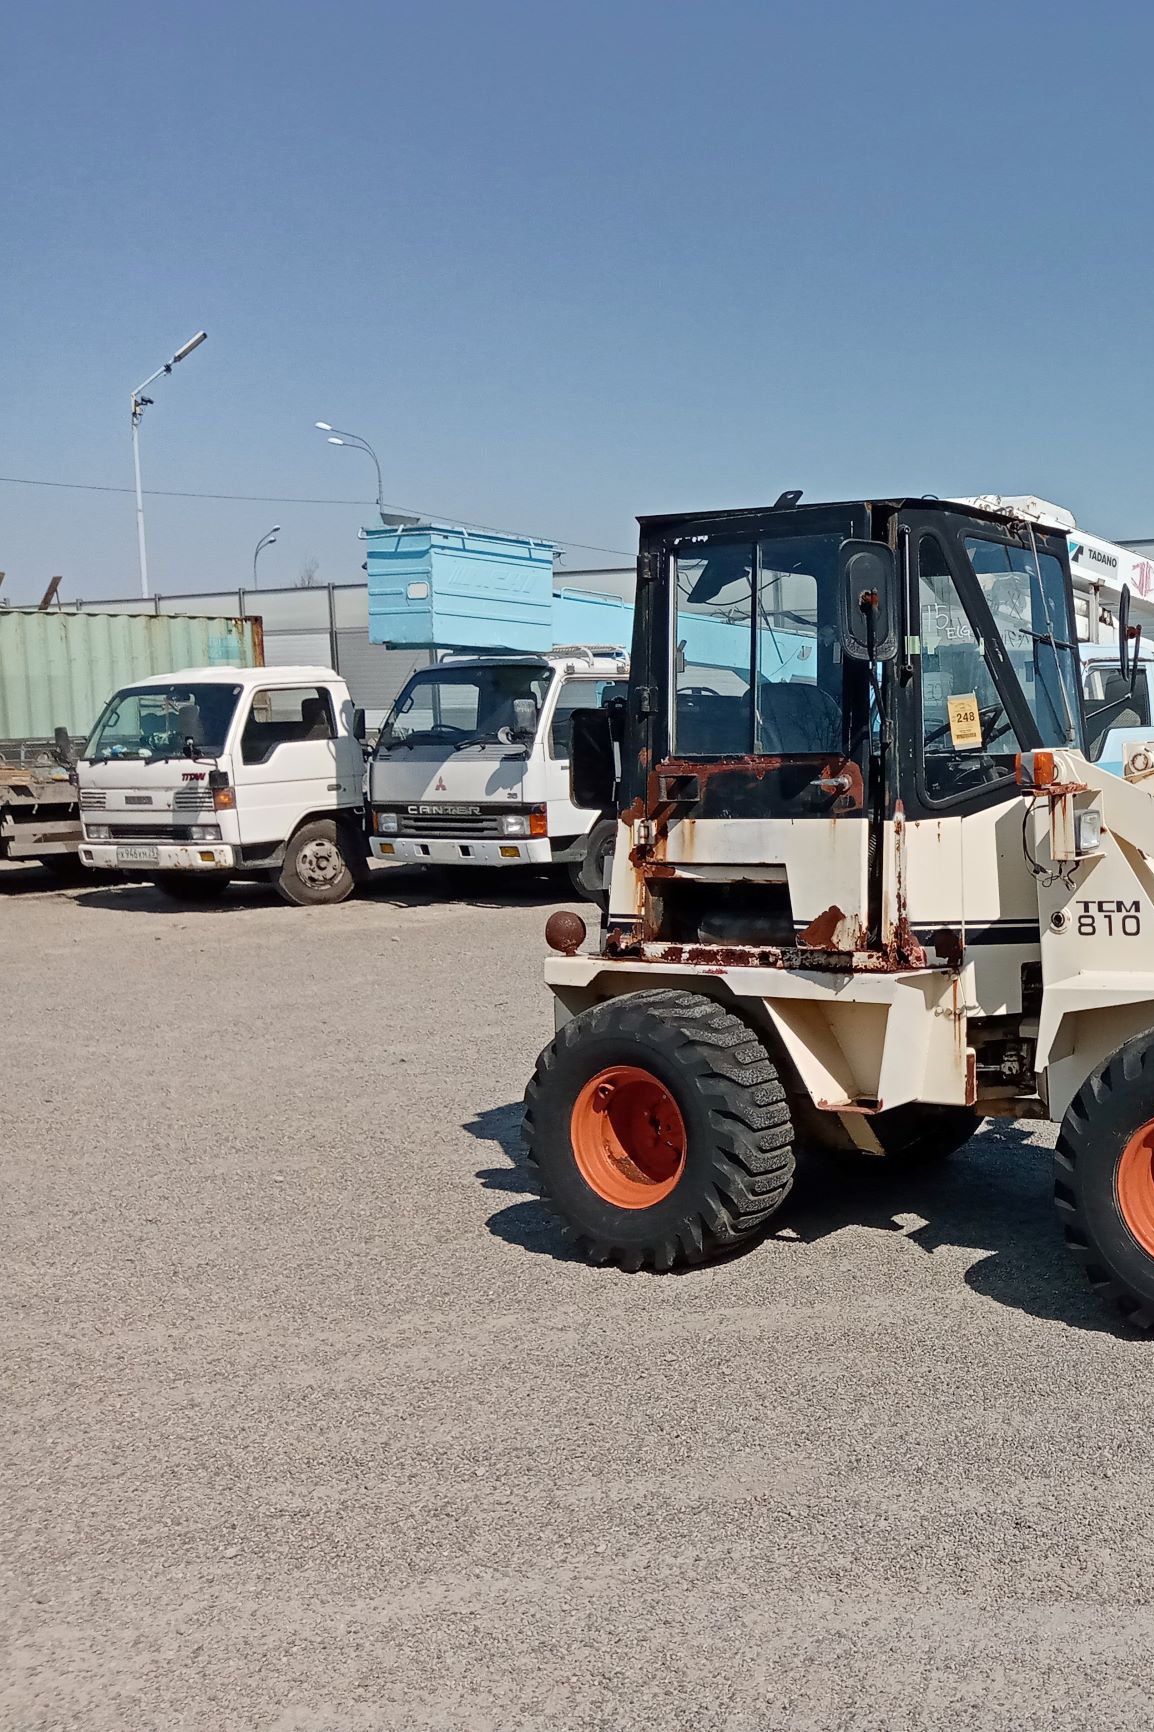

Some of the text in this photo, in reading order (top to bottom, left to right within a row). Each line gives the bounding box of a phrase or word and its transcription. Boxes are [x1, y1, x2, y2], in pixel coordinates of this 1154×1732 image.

[1088, 548, 1118, 568] TADANO
[956, 711, 976, 723] 248
[407, 805, 482, 815] CANTER
[1076, 900, 1141, 913] TCM
[1078, 914, 1141, 936] 810
